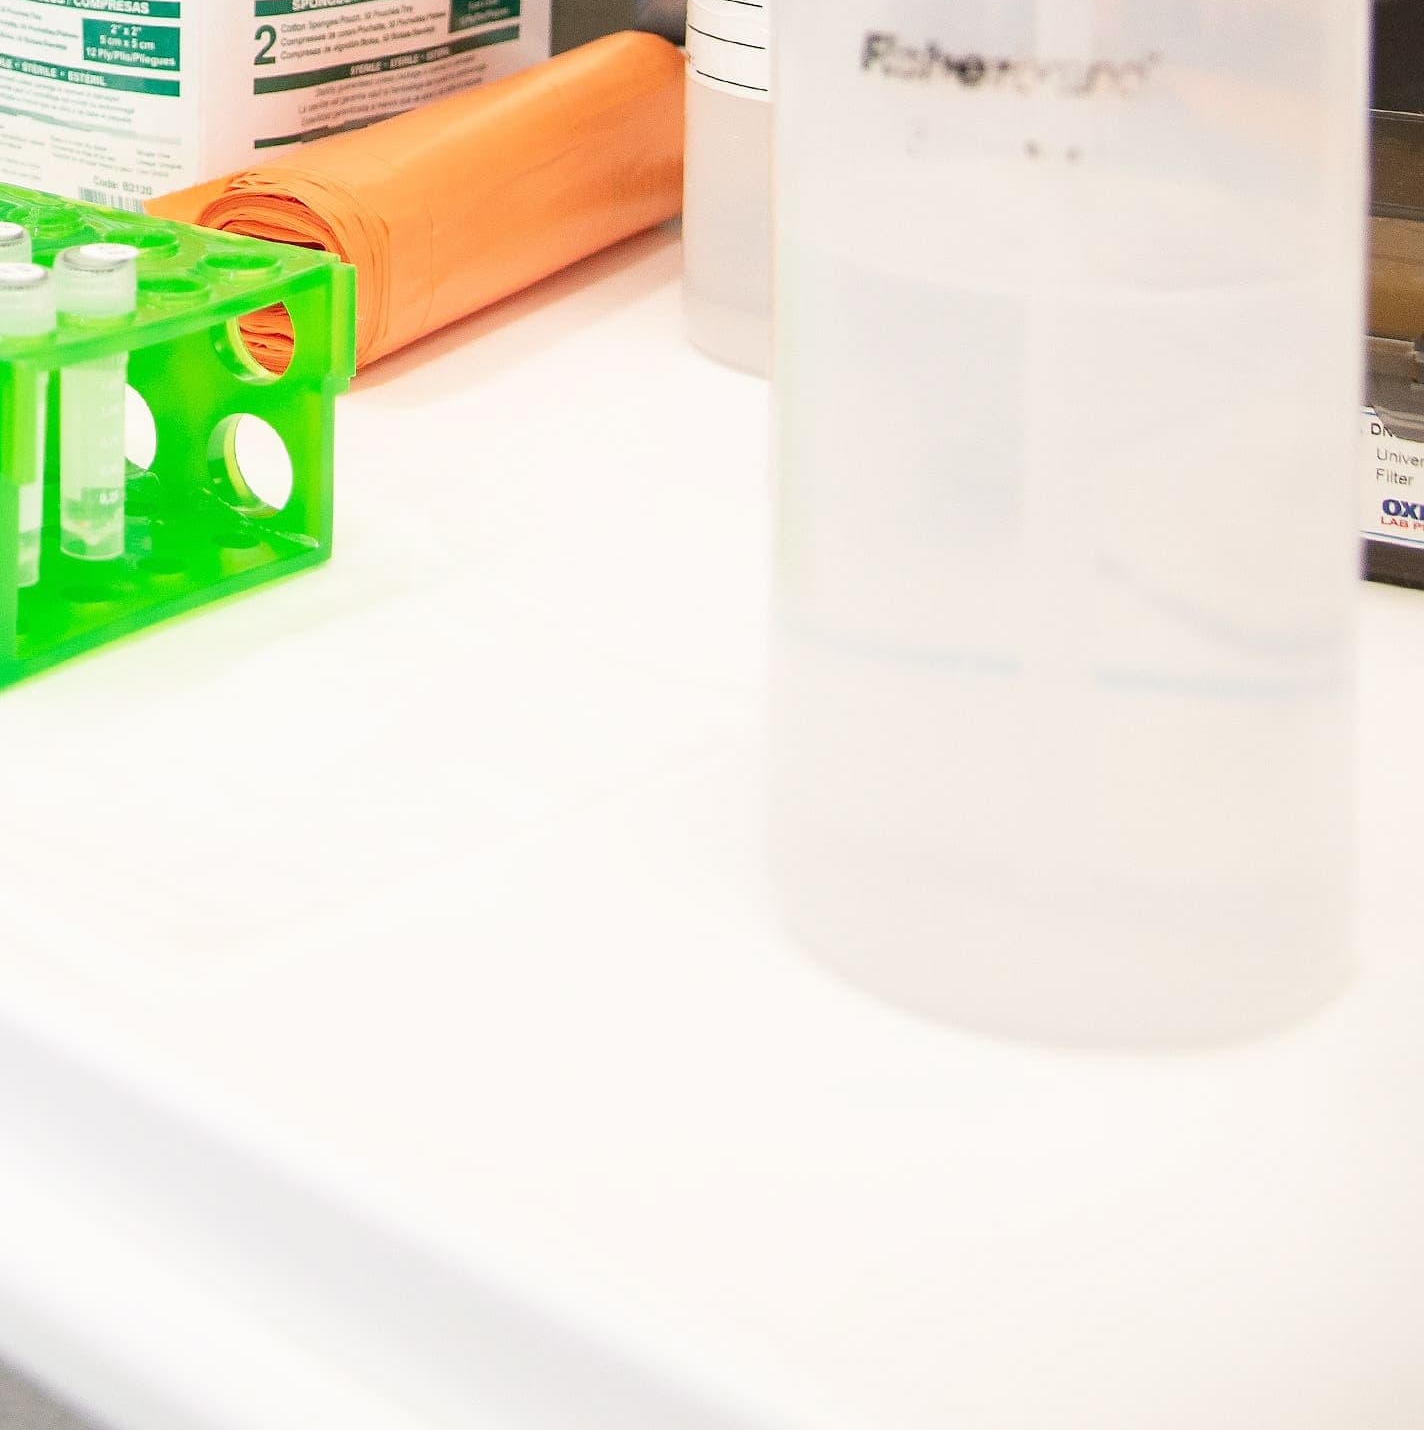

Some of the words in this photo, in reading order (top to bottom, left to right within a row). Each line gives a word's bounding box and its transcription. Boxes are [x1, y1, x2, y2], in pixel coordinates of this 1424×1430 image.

[254, 24, 276, 65] 2
[1376, 468, 1414, 486] Filter
[1381, 516, 1408, 528] LAB
